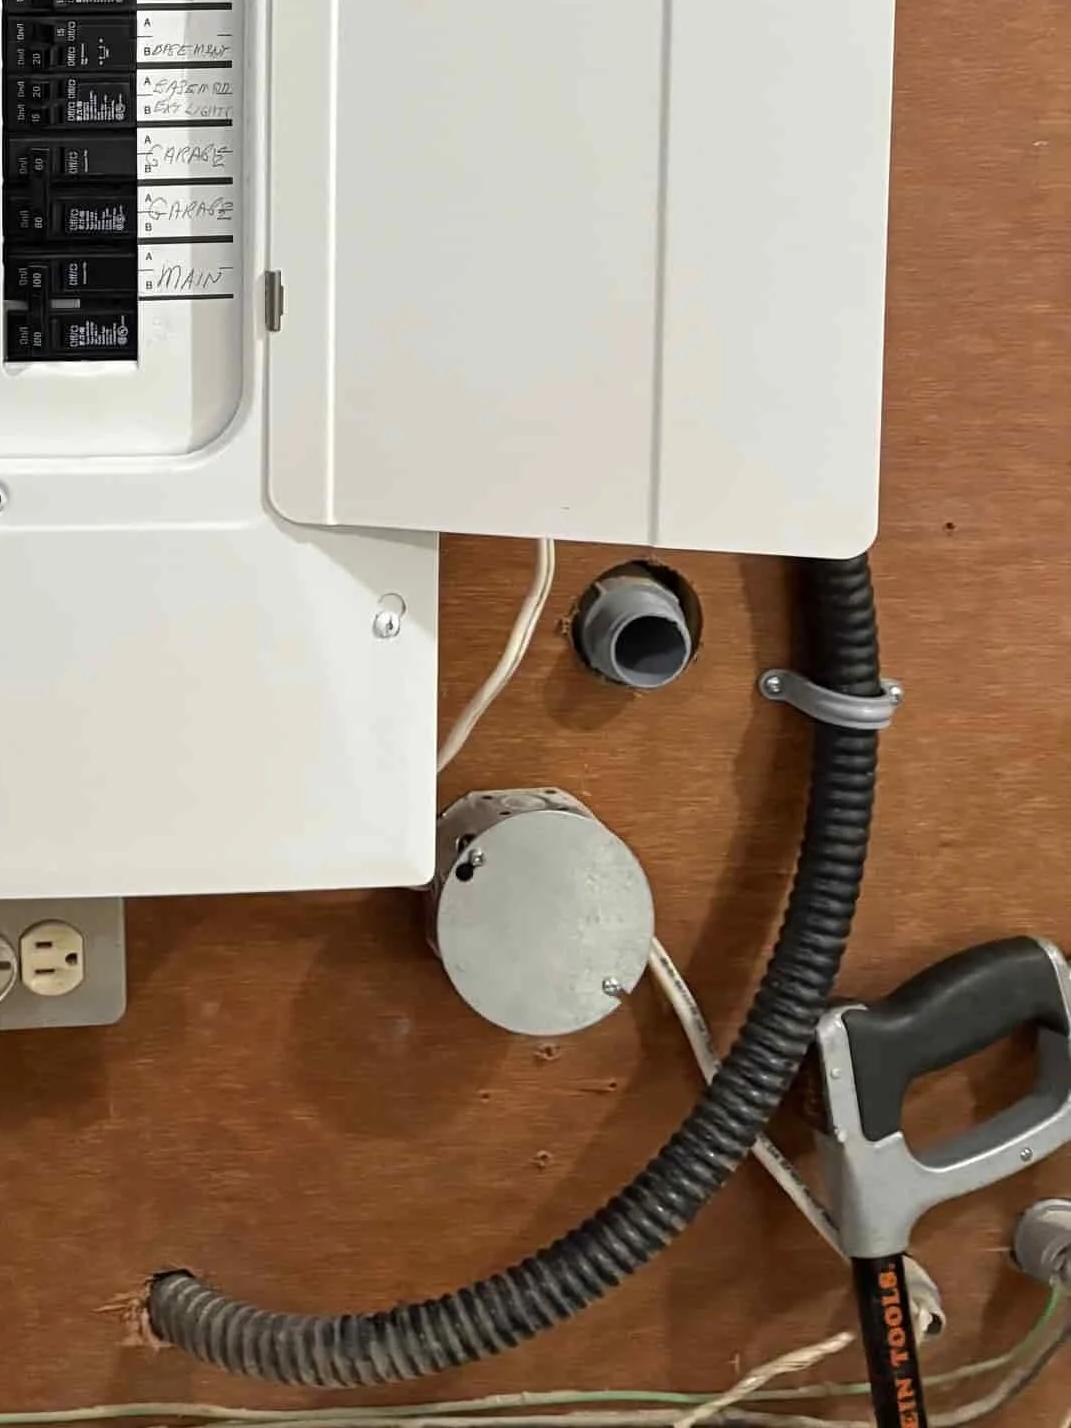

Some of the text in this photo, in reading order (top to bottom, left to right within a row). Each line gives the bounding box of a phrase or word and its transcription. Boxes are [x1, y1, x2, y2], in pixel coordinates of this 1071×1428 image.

[146, 144, 228, 167] GARAGE
[145, 194, 152, 202] A
[149, 197, 233, 220] GARAGE
[145, 223, 152, 231] B
[157, 261, 222, 289] MAIN
